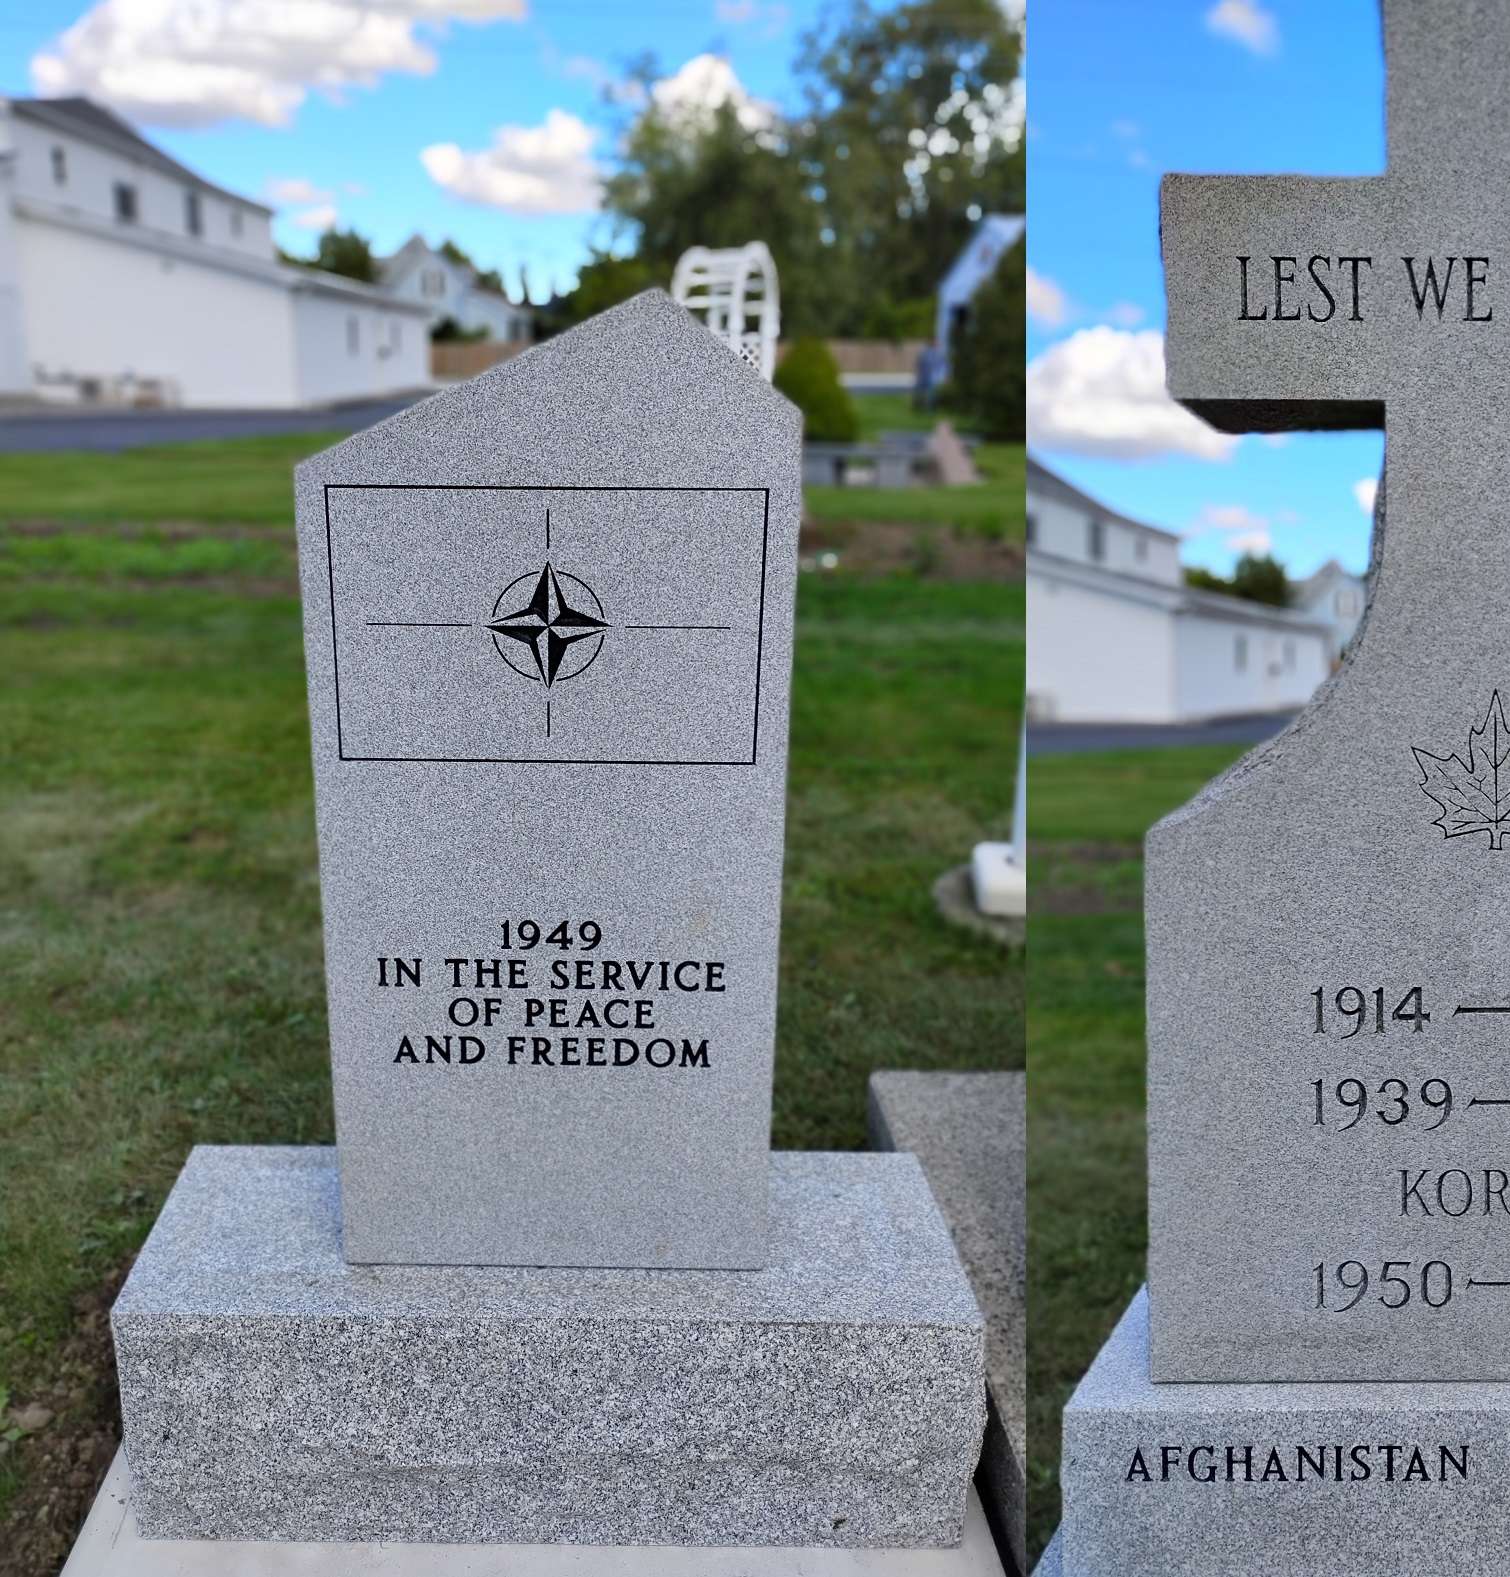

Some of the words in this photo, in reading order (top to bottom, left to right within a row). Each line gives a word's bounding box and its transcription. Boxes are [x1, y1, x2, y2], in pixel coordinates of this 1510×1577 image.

[1236, 254, 1372, 322] LEST
[1401, 256, 1493, 321] WE
[500, 919, 602, 951] 1949
[377, 957, 421, 987] IN
[444, 958, 528, 989] THE
[550, 960, 726, 992] SERVICE
[448, 997, 501, 1027] OF
[524, 998, 655, 1029] PEACE
[1310, 986, 1431, 1039] 1914
[393, 1035, 485, 1064] AND
[507, 1036, 711, 1068] FREEDOM
[1125, 1445, 1470, 1483] AFGHANISTAN
